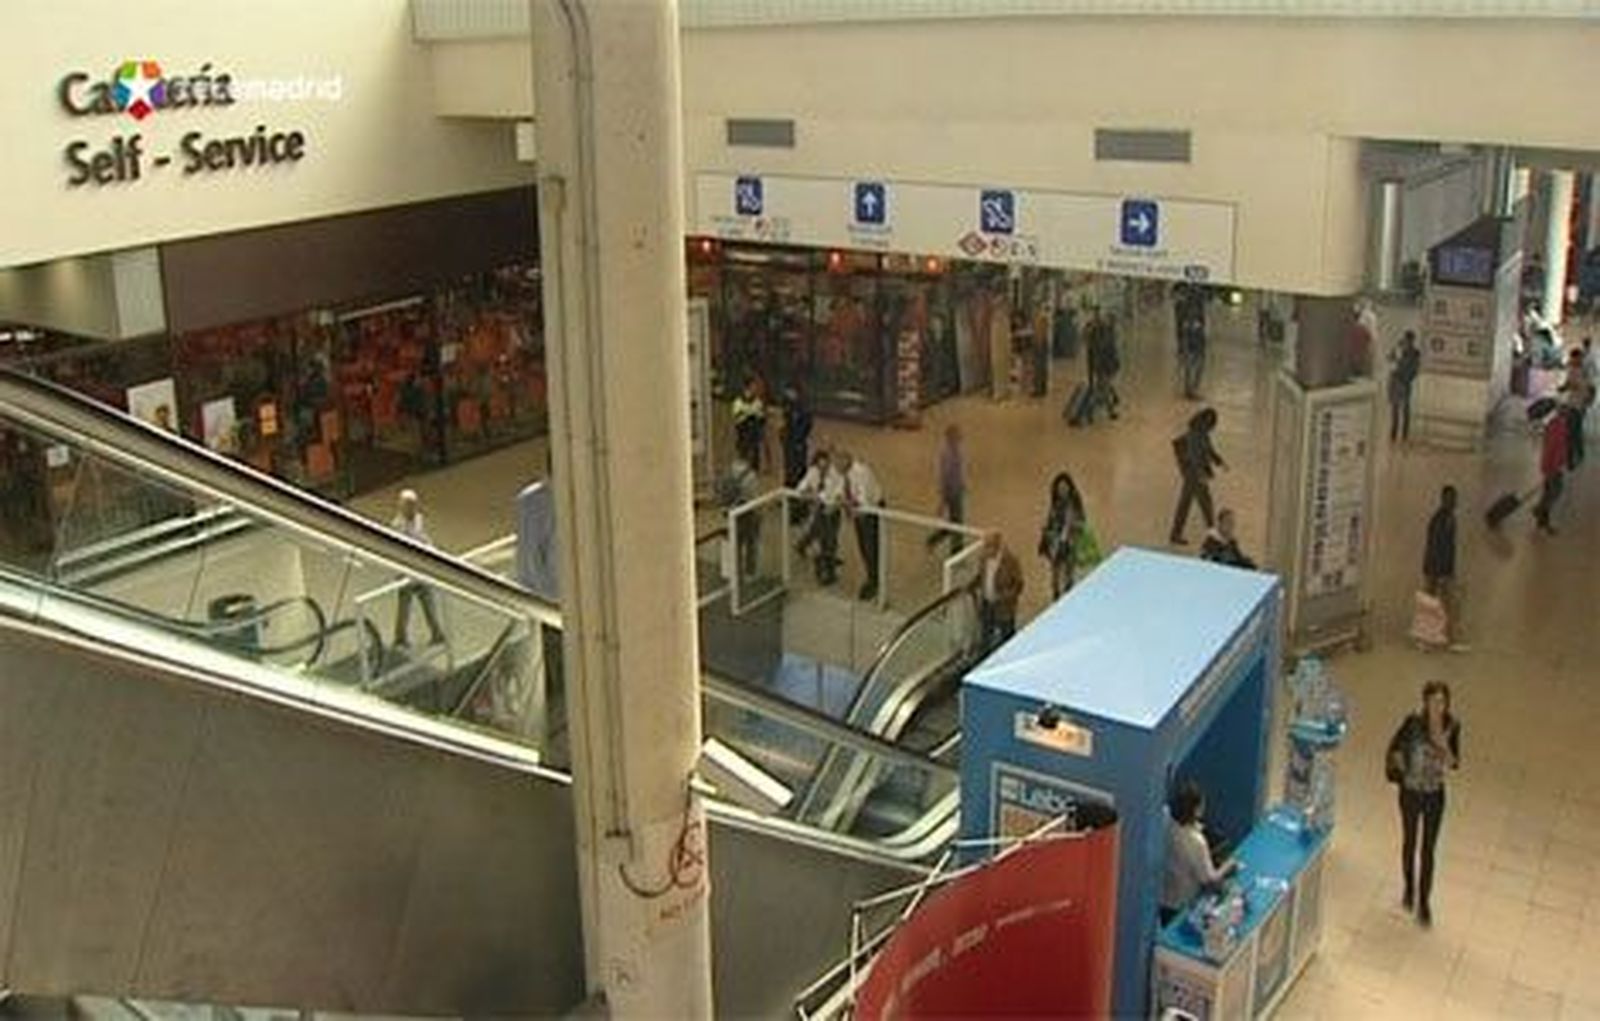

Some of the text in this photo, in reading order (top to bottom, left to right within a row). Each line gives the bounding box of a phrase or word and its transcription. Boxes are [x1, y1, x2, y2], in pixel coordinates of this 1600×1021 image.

[59, 62, 236, 117] Caería
[64, 134, 142, 187] Self
[180, 124, 305, 176] Service
